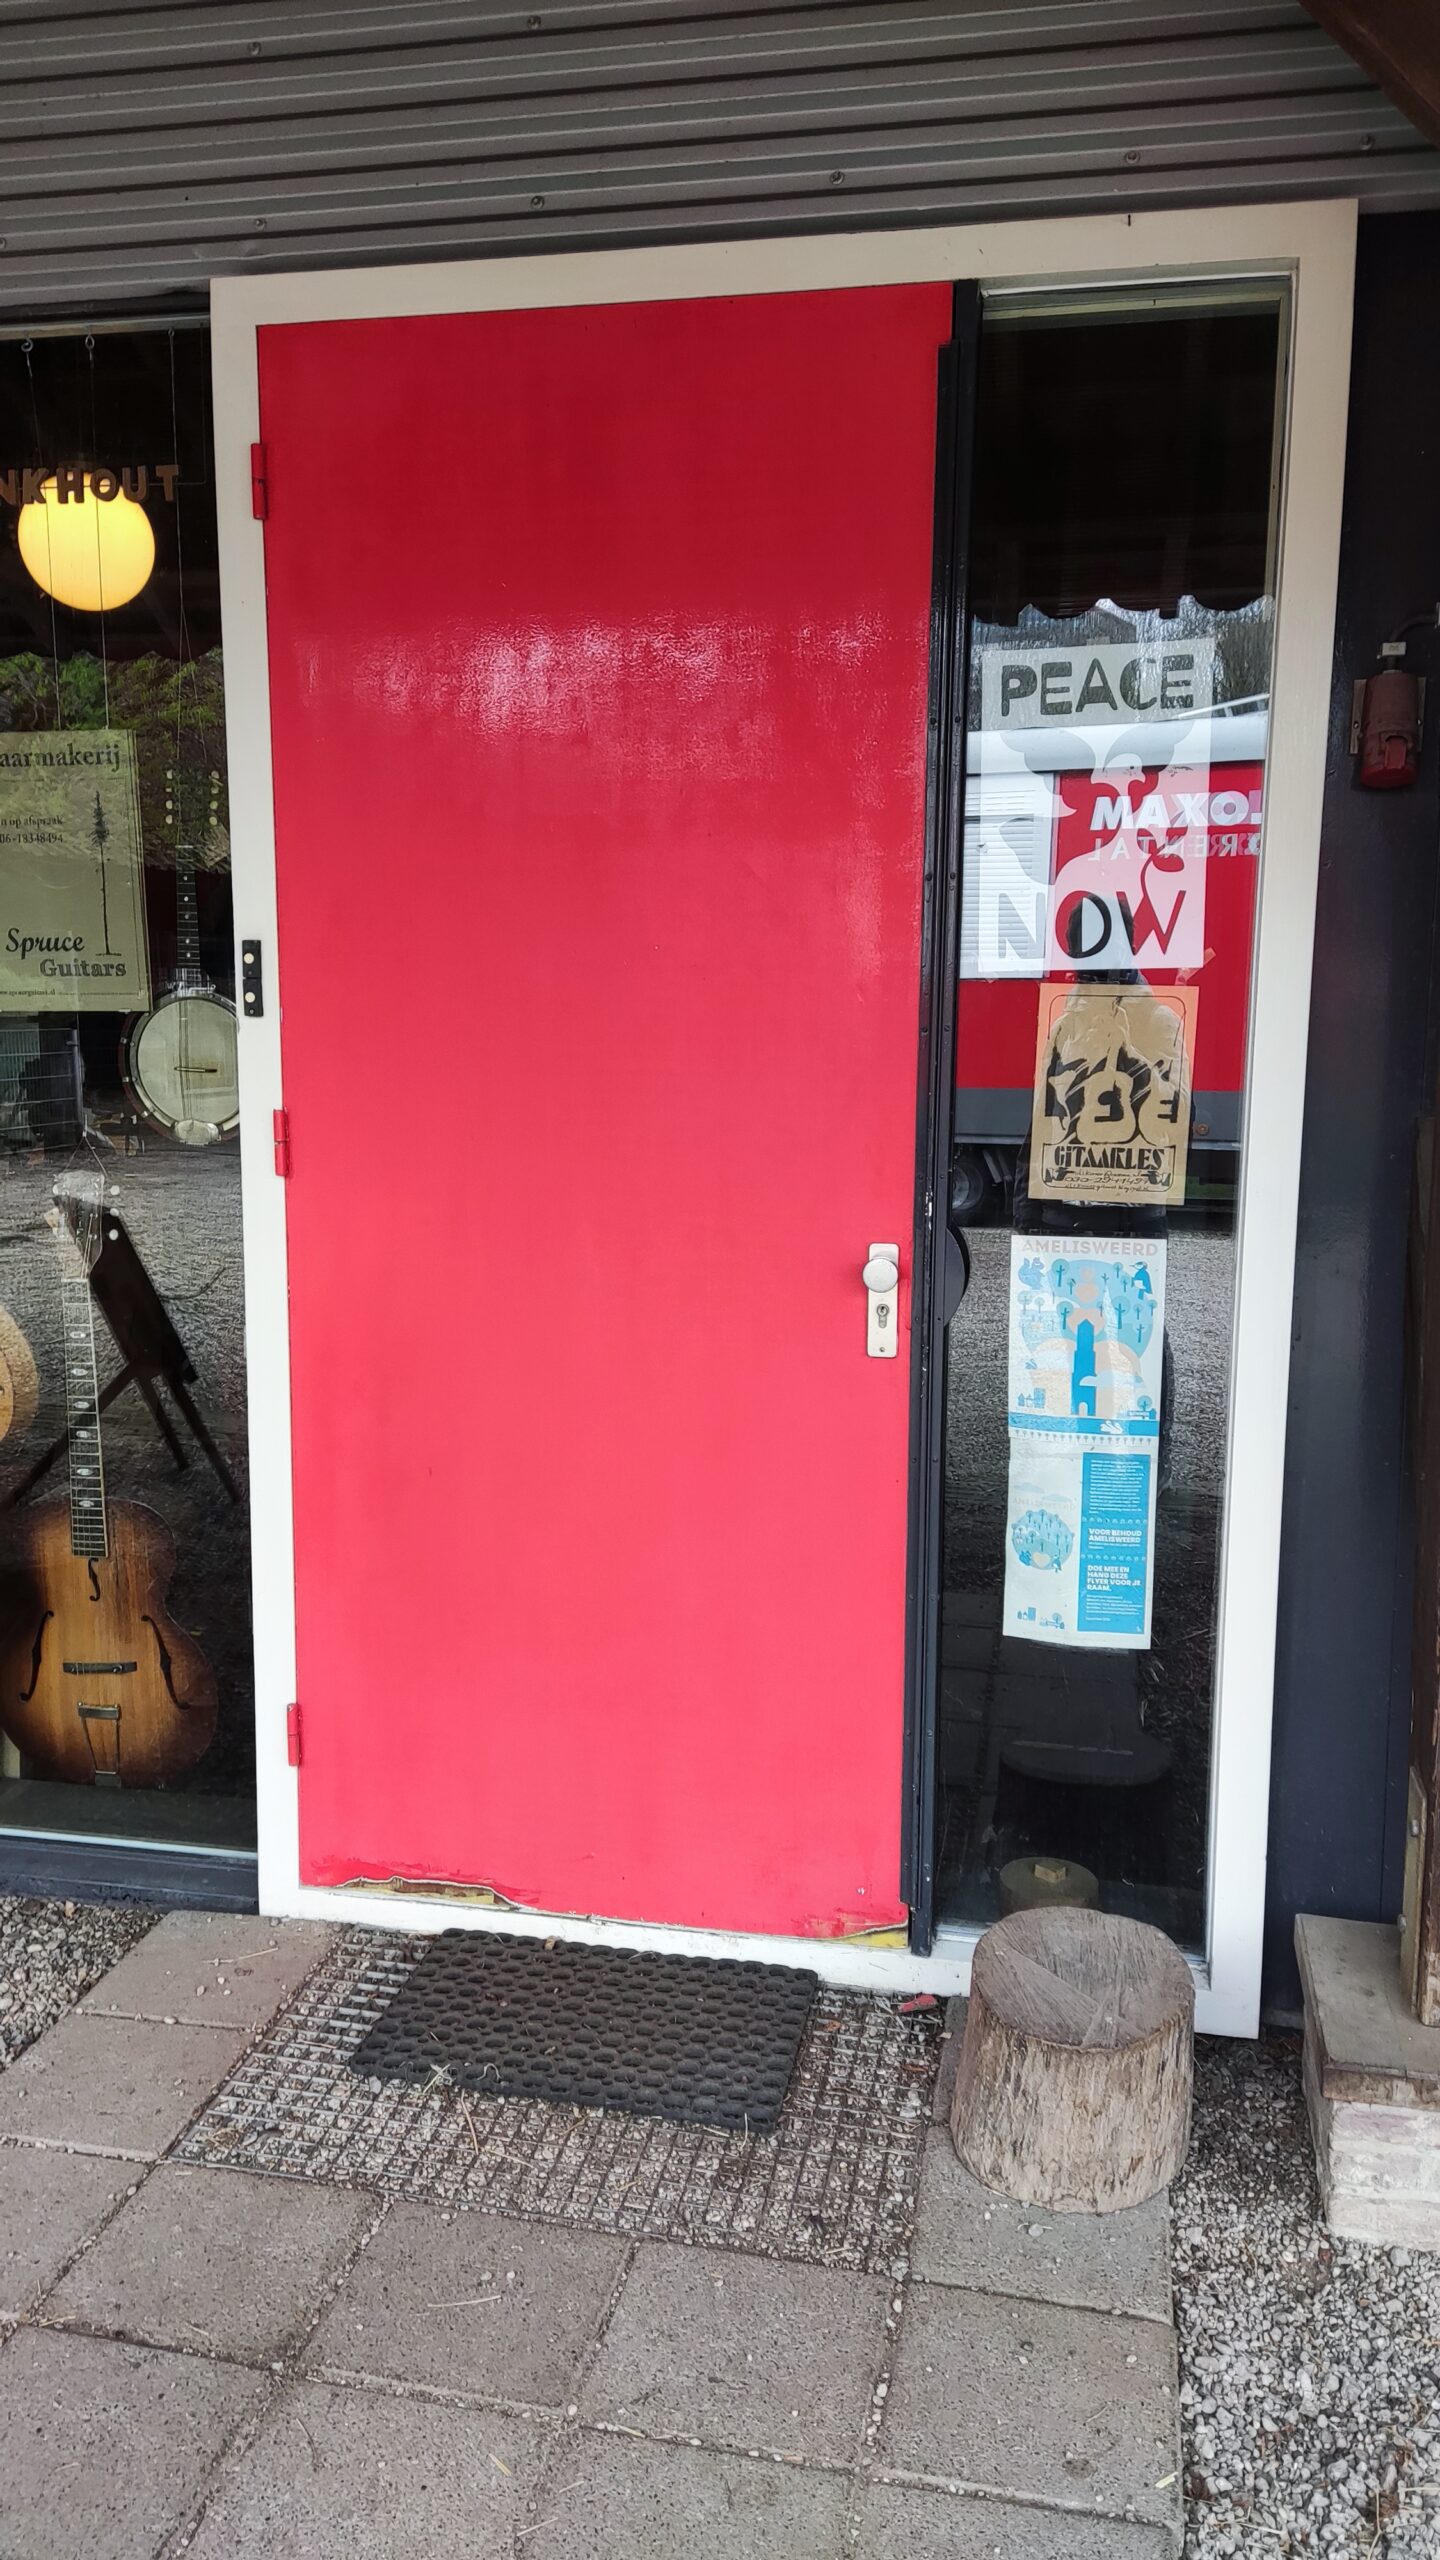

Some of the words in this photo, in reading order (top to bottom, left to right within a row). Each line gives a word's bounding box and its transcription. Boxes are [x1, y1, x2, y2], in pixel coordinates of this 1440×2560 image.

[1001, 653, 1194, 717] PEACE
[9, 818, 21, 829] op
[998, 889, 1187, 960] NOW
[5, 927, 86, 960] Spruce
[40, 957, 127, 977] Guitars
[1022, 1238, 1158, 1257] AMELISWEERD
